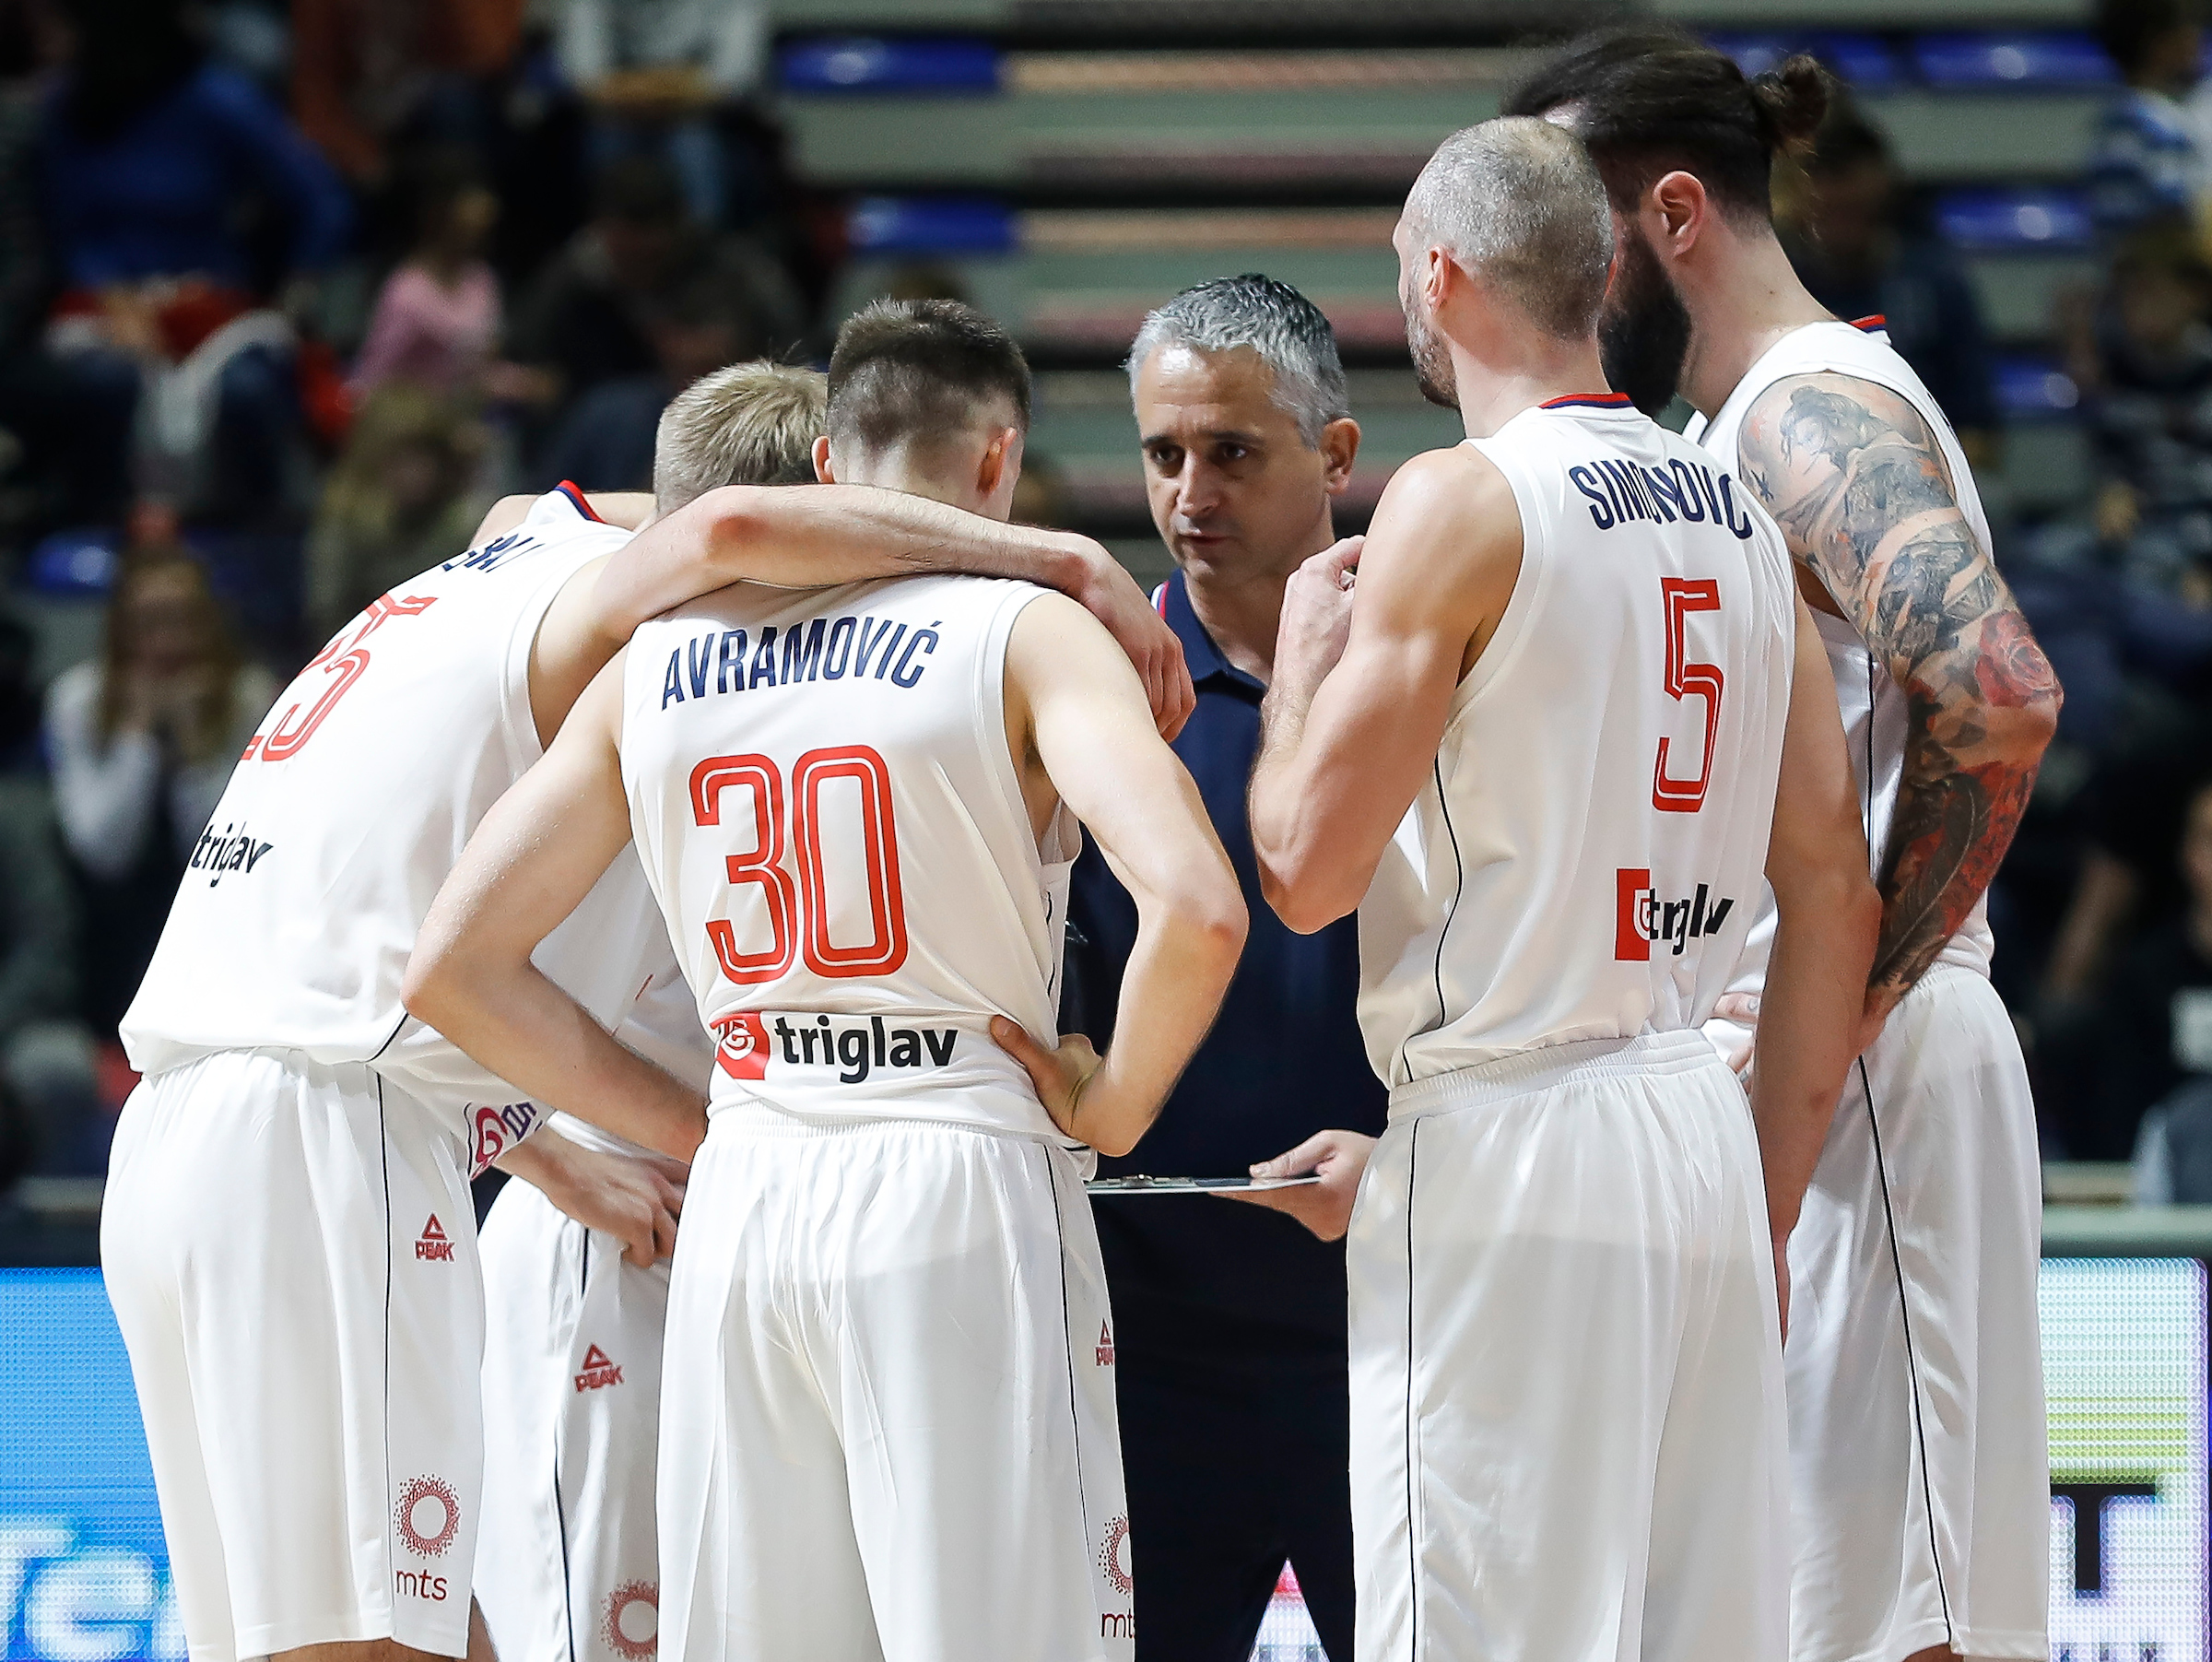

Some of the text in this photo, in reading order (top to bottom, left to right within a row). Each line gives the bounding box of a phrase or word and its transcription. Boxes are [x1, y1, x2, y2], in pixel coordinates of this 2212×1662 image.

[661, 616, 942, 711] AVRAMOVIĆ
[1652, 577, 1724, 813] 5
[688, 744, 909, 984] 30
[773, 1014, 959, 1084] triglav
[415, 1240, 455, 1262] PEAK
[574, 1366, 624, 1393] PEAK
[396, 1568, 448, 1601] mts
[1101, 1608, 1134, 1639] mt
